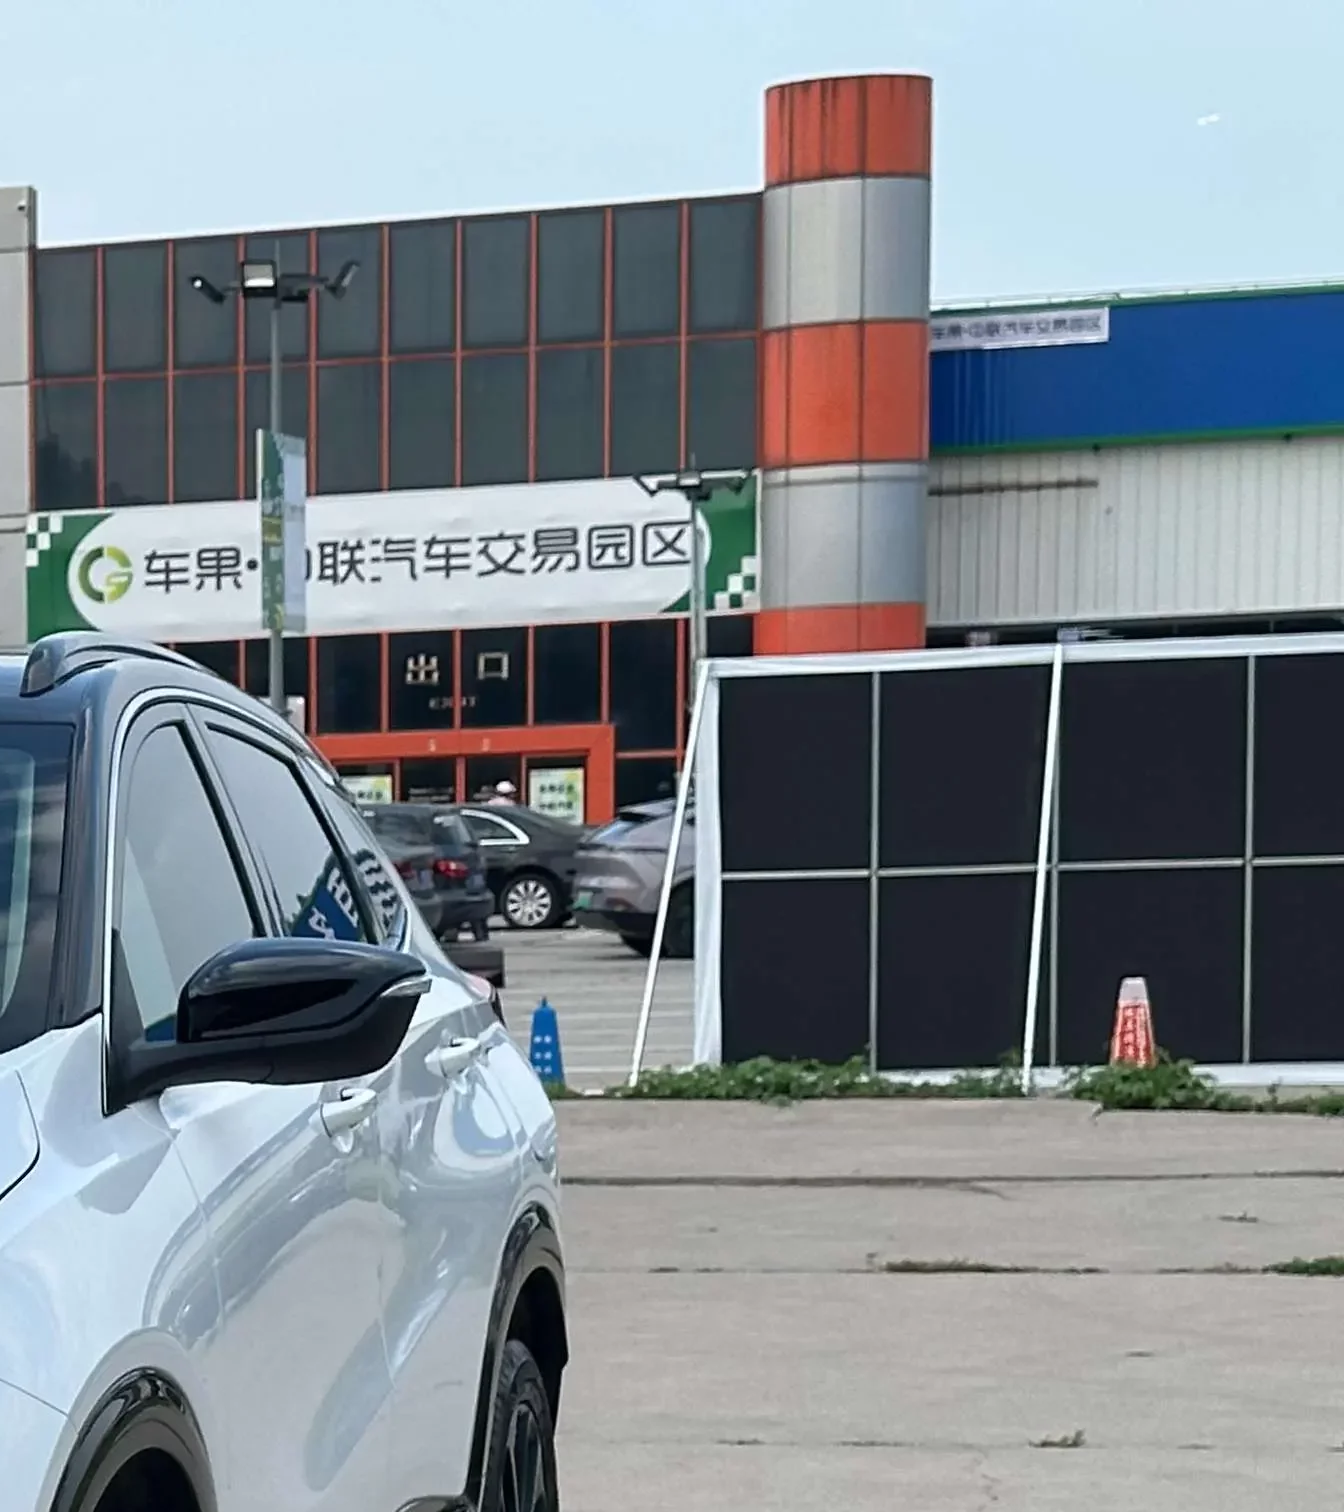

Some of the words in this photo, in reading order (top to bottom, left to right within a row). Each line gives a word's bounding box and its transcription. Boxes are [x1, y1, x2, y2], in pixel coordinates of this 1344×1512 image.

[142, 519, 696, 594] 车果·联汽车交易园区
[405, 651, 509, 685] 出口
